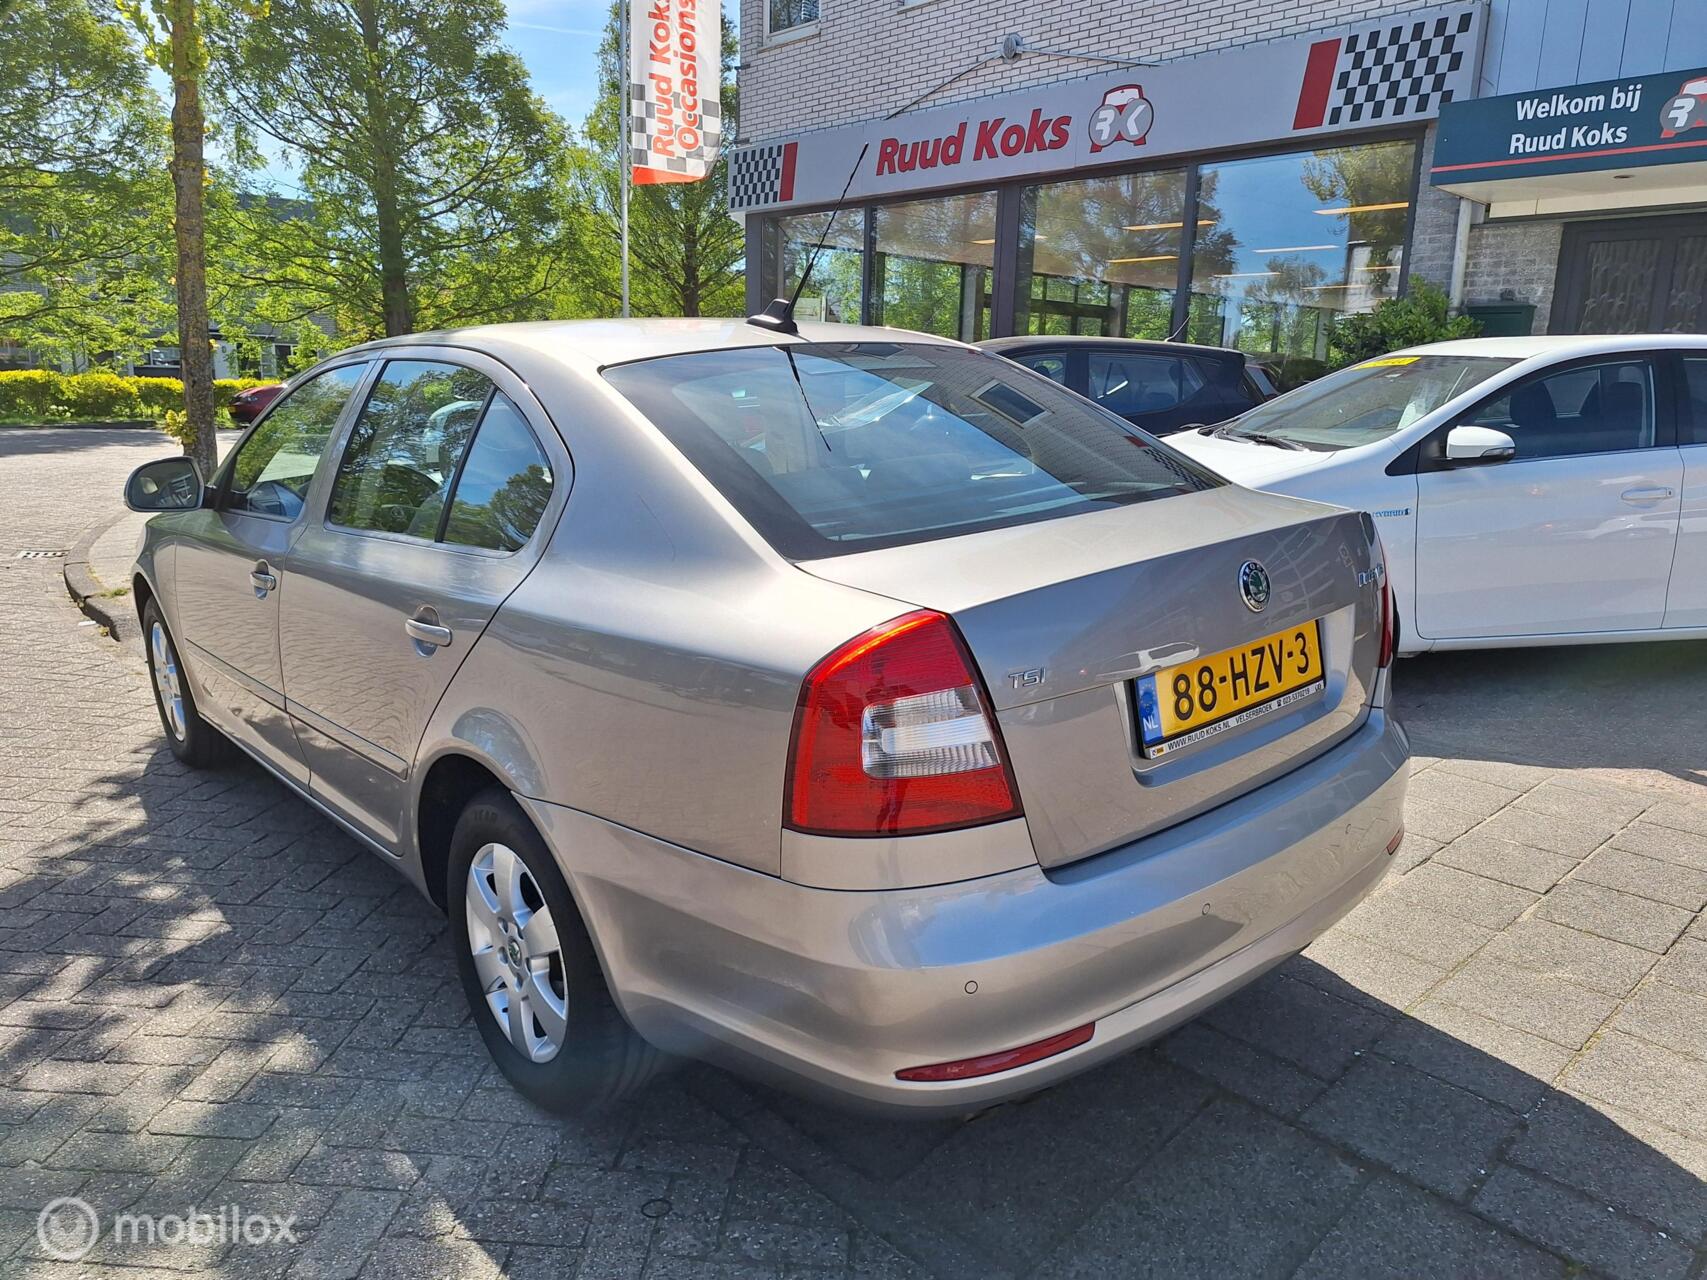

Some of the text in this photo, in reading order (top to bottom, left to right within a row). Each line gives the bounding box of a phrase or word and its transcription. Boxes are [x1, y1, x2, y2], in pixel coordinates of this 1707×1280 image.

[648, 0, 675, 158] Ruud Kok
[674, 0, 699, 151] Occasions
[1516, 84, 1643, 121] Welkom bij
[876, 108, 1072, 176] Ruud Koks
[1509, 122, 1628, 154] Ruud Koks
[1008, 667, 1046, 689] TSI
[1172, 632, 1310, 721] 88-HZV-3
[1142, 715, 1159, 732] NL
